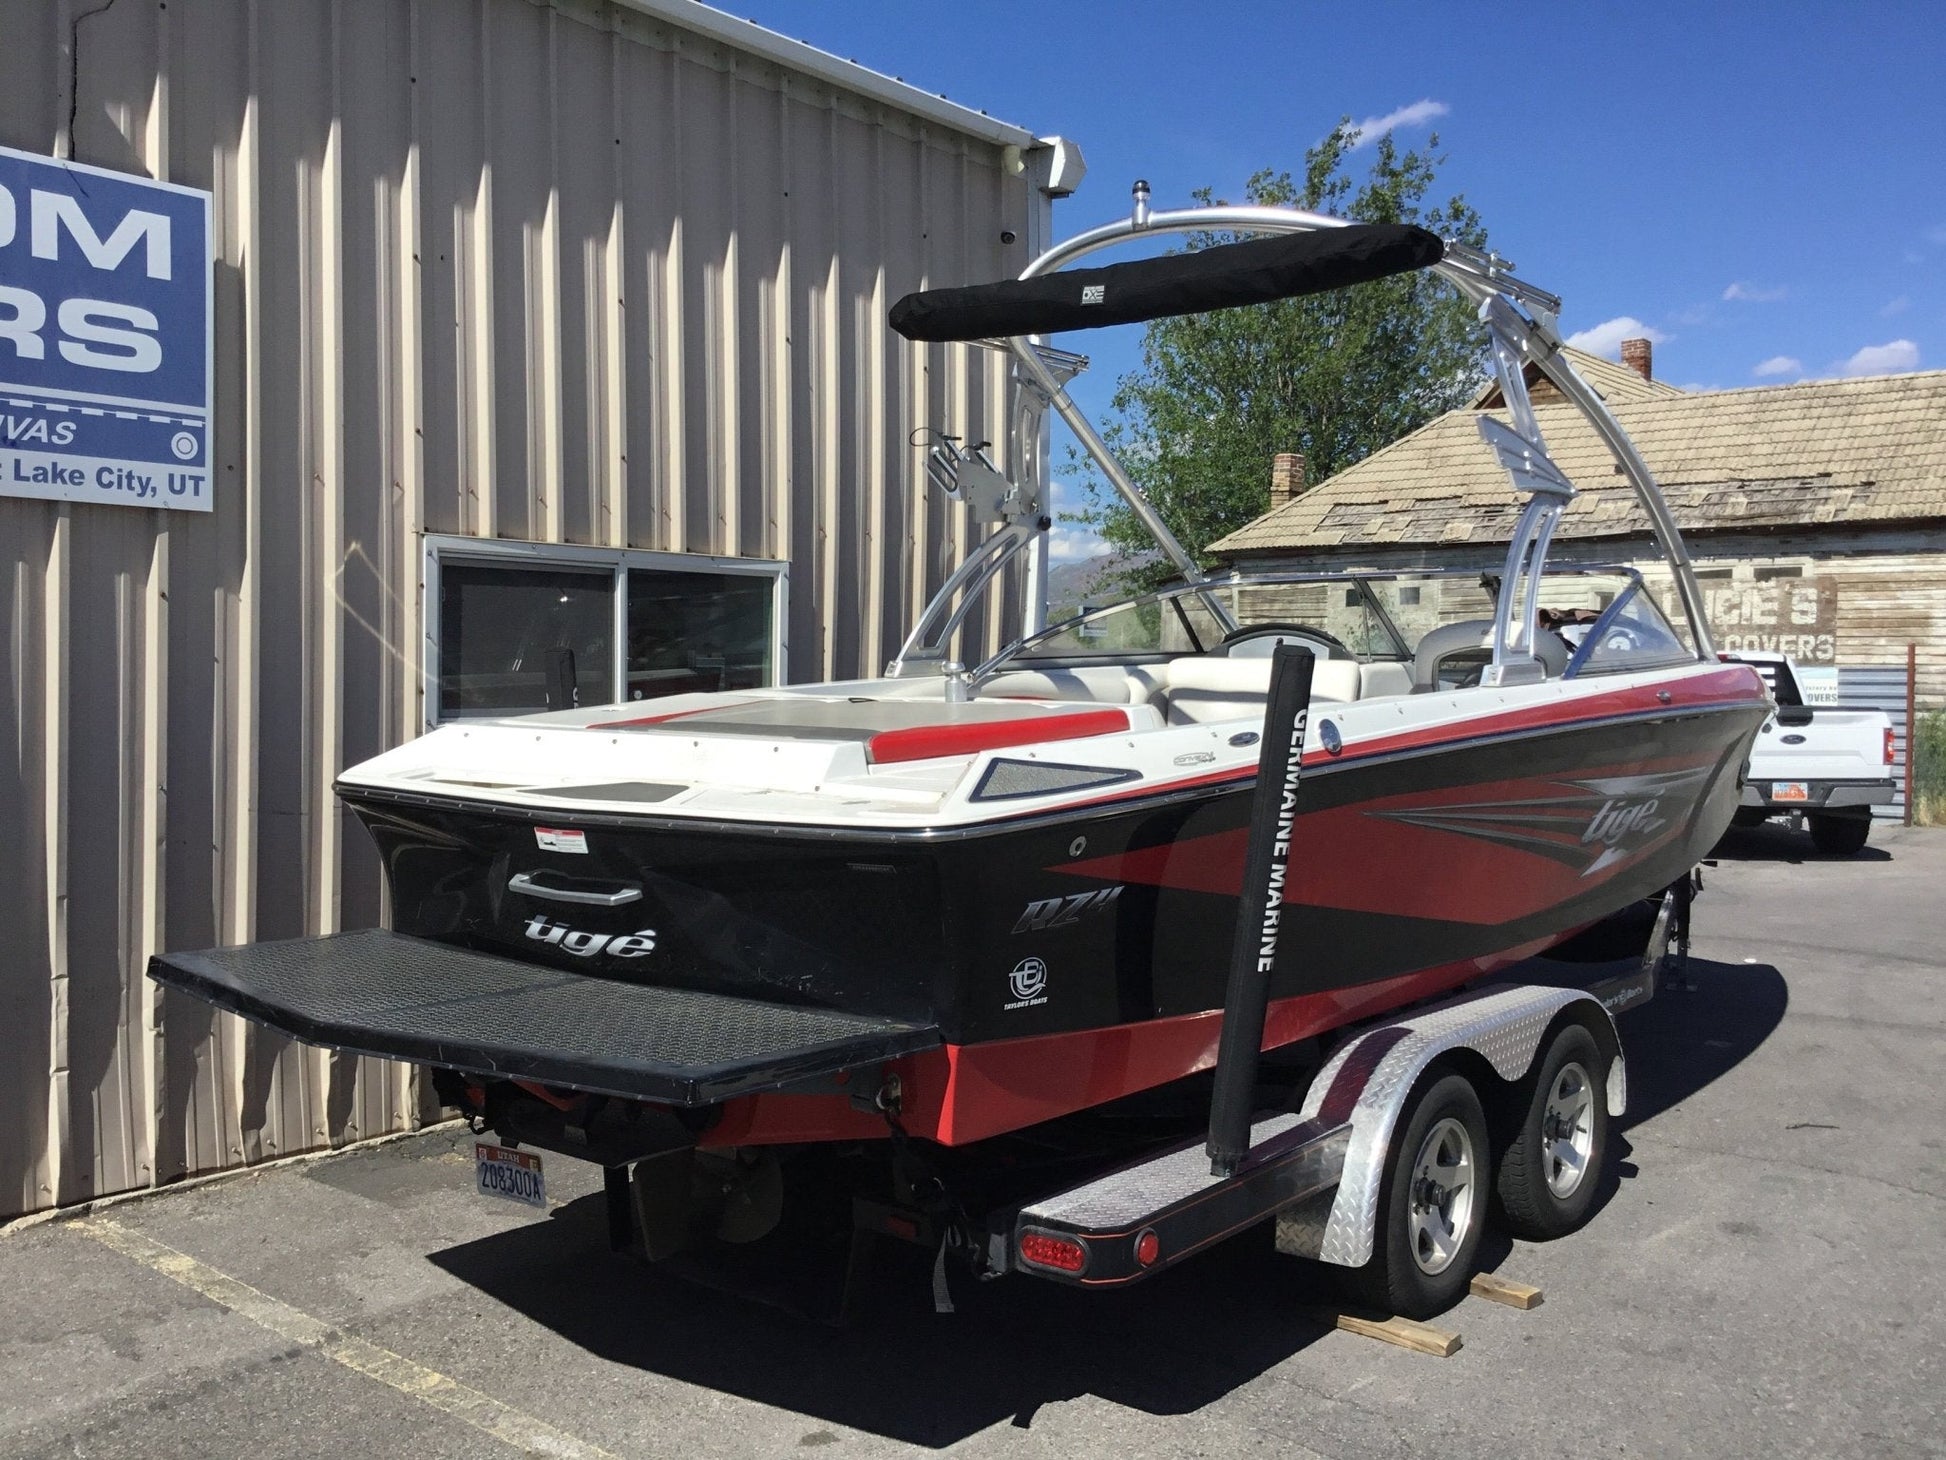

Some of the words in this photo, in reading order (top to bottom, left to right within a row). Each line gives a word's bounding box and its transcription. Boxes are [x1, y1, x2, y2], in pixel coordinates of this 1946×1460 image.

[14, 458, 85, 487] Lake
[95, 466, 157, 498] City,
[168, 473, 206, 497] UT
[1724, 634, 1835, 660] COVERS
[1273, 708, 1308, 857] GERMAINE
[1257, 863, 1288, 973] MARINE
